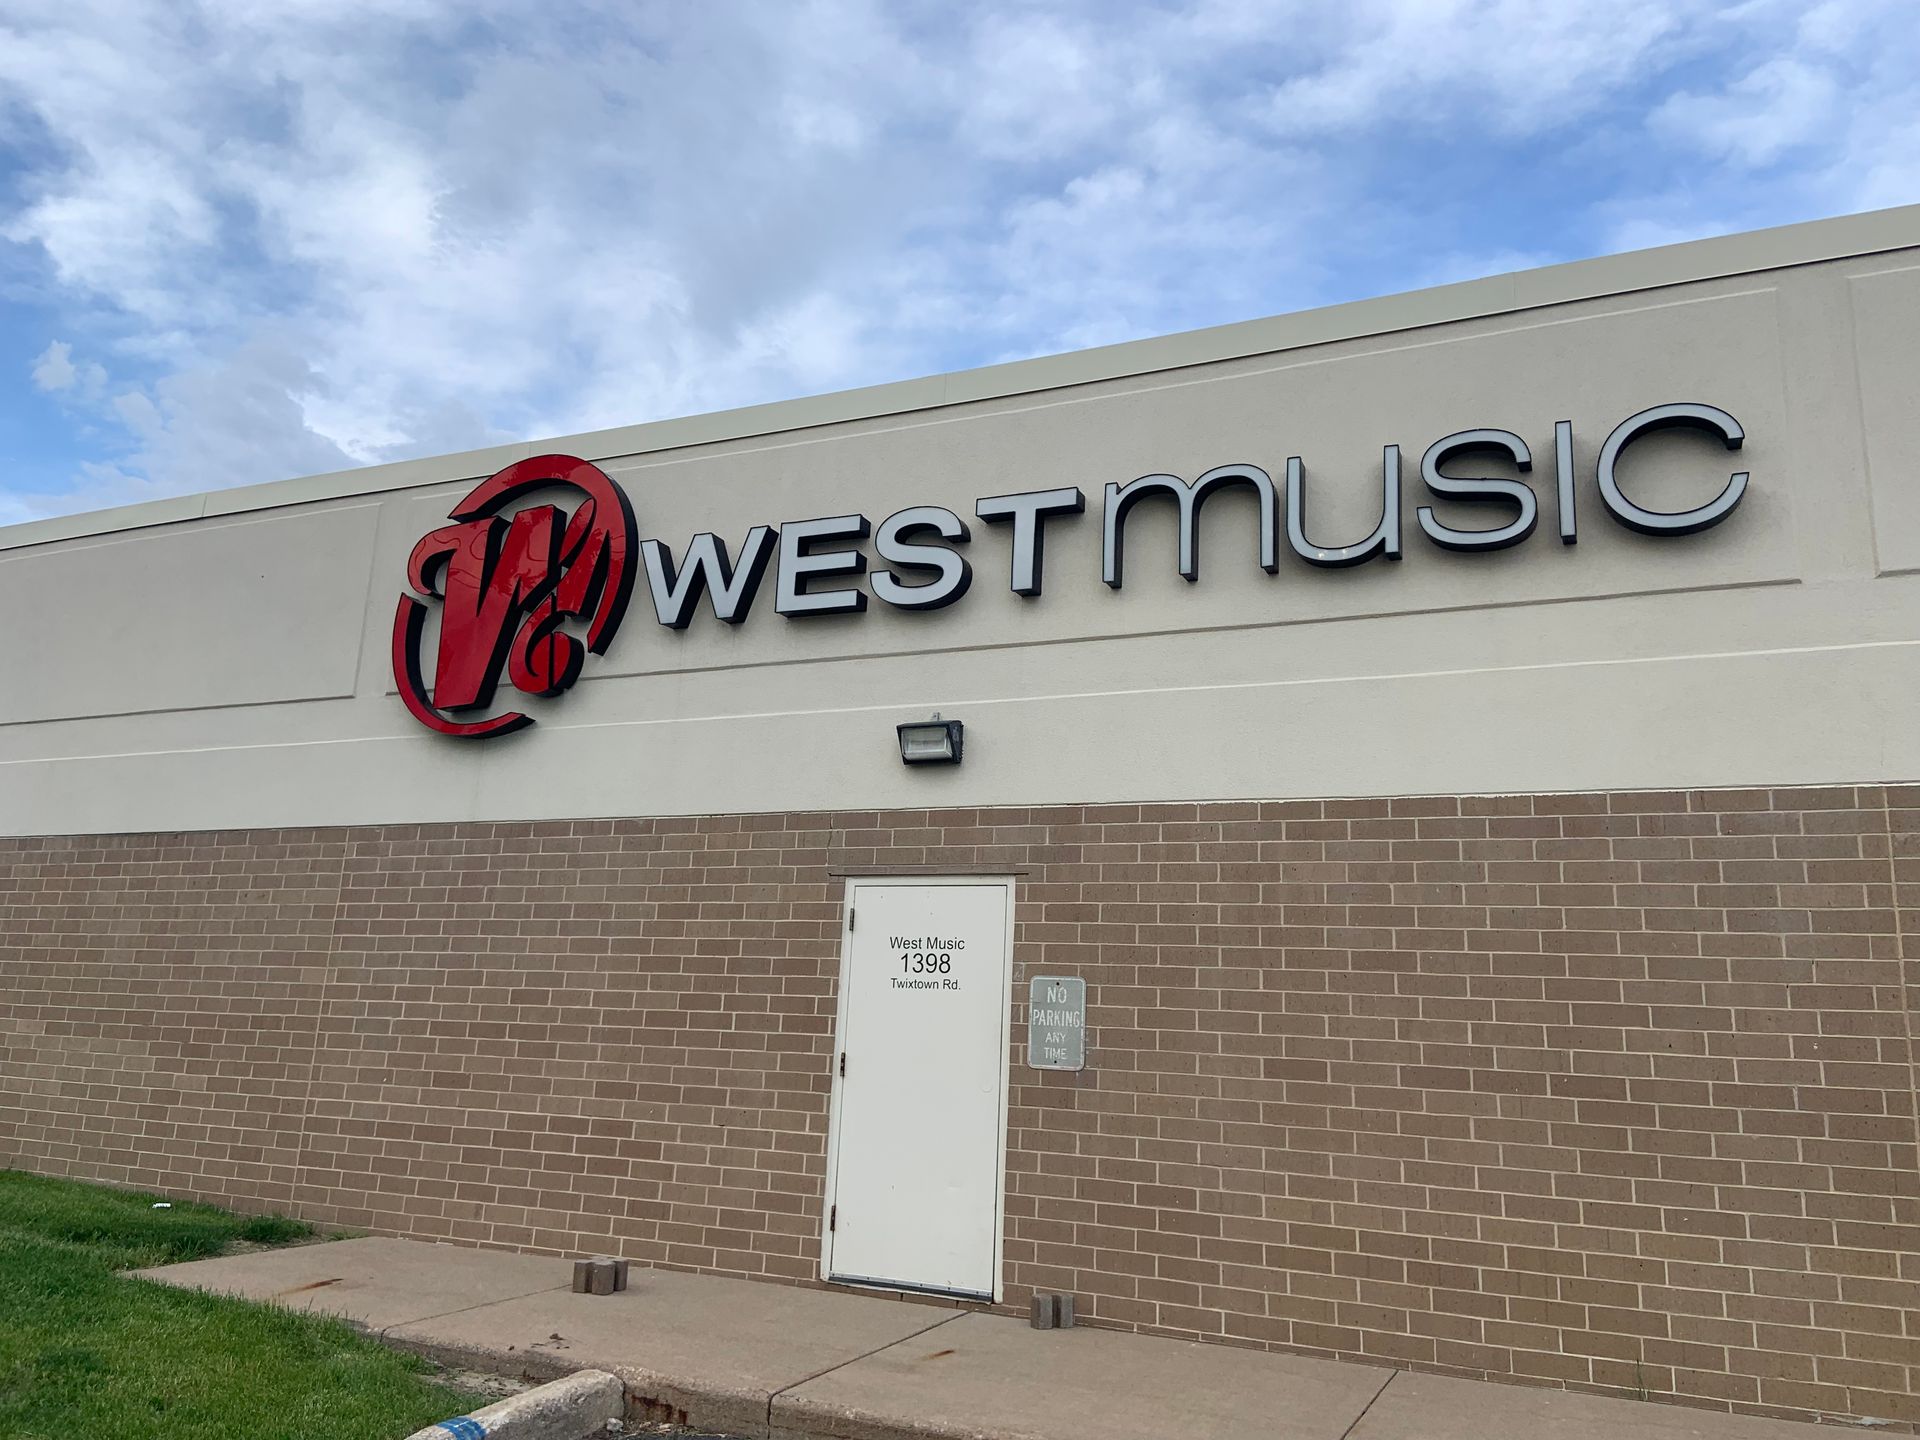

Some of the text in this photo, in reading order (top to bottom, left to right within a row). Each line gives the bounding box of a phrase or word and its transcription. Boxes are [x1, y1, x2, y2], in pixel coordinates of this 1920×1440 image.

[640, 486, 1084, 630] WEST
[889, 936, 966, 950] West Music
[900, 952, 951, 974] 1398
[890, 977, 961, 991] Twixtown Rd.
[1047, 986, 1067, 1004] NO
[1032, 1009, 1080, 1028] PARKING
[1045, 1031, 1066, 1044] ANY
[1043, 1047, 1068, 1060] TIME
